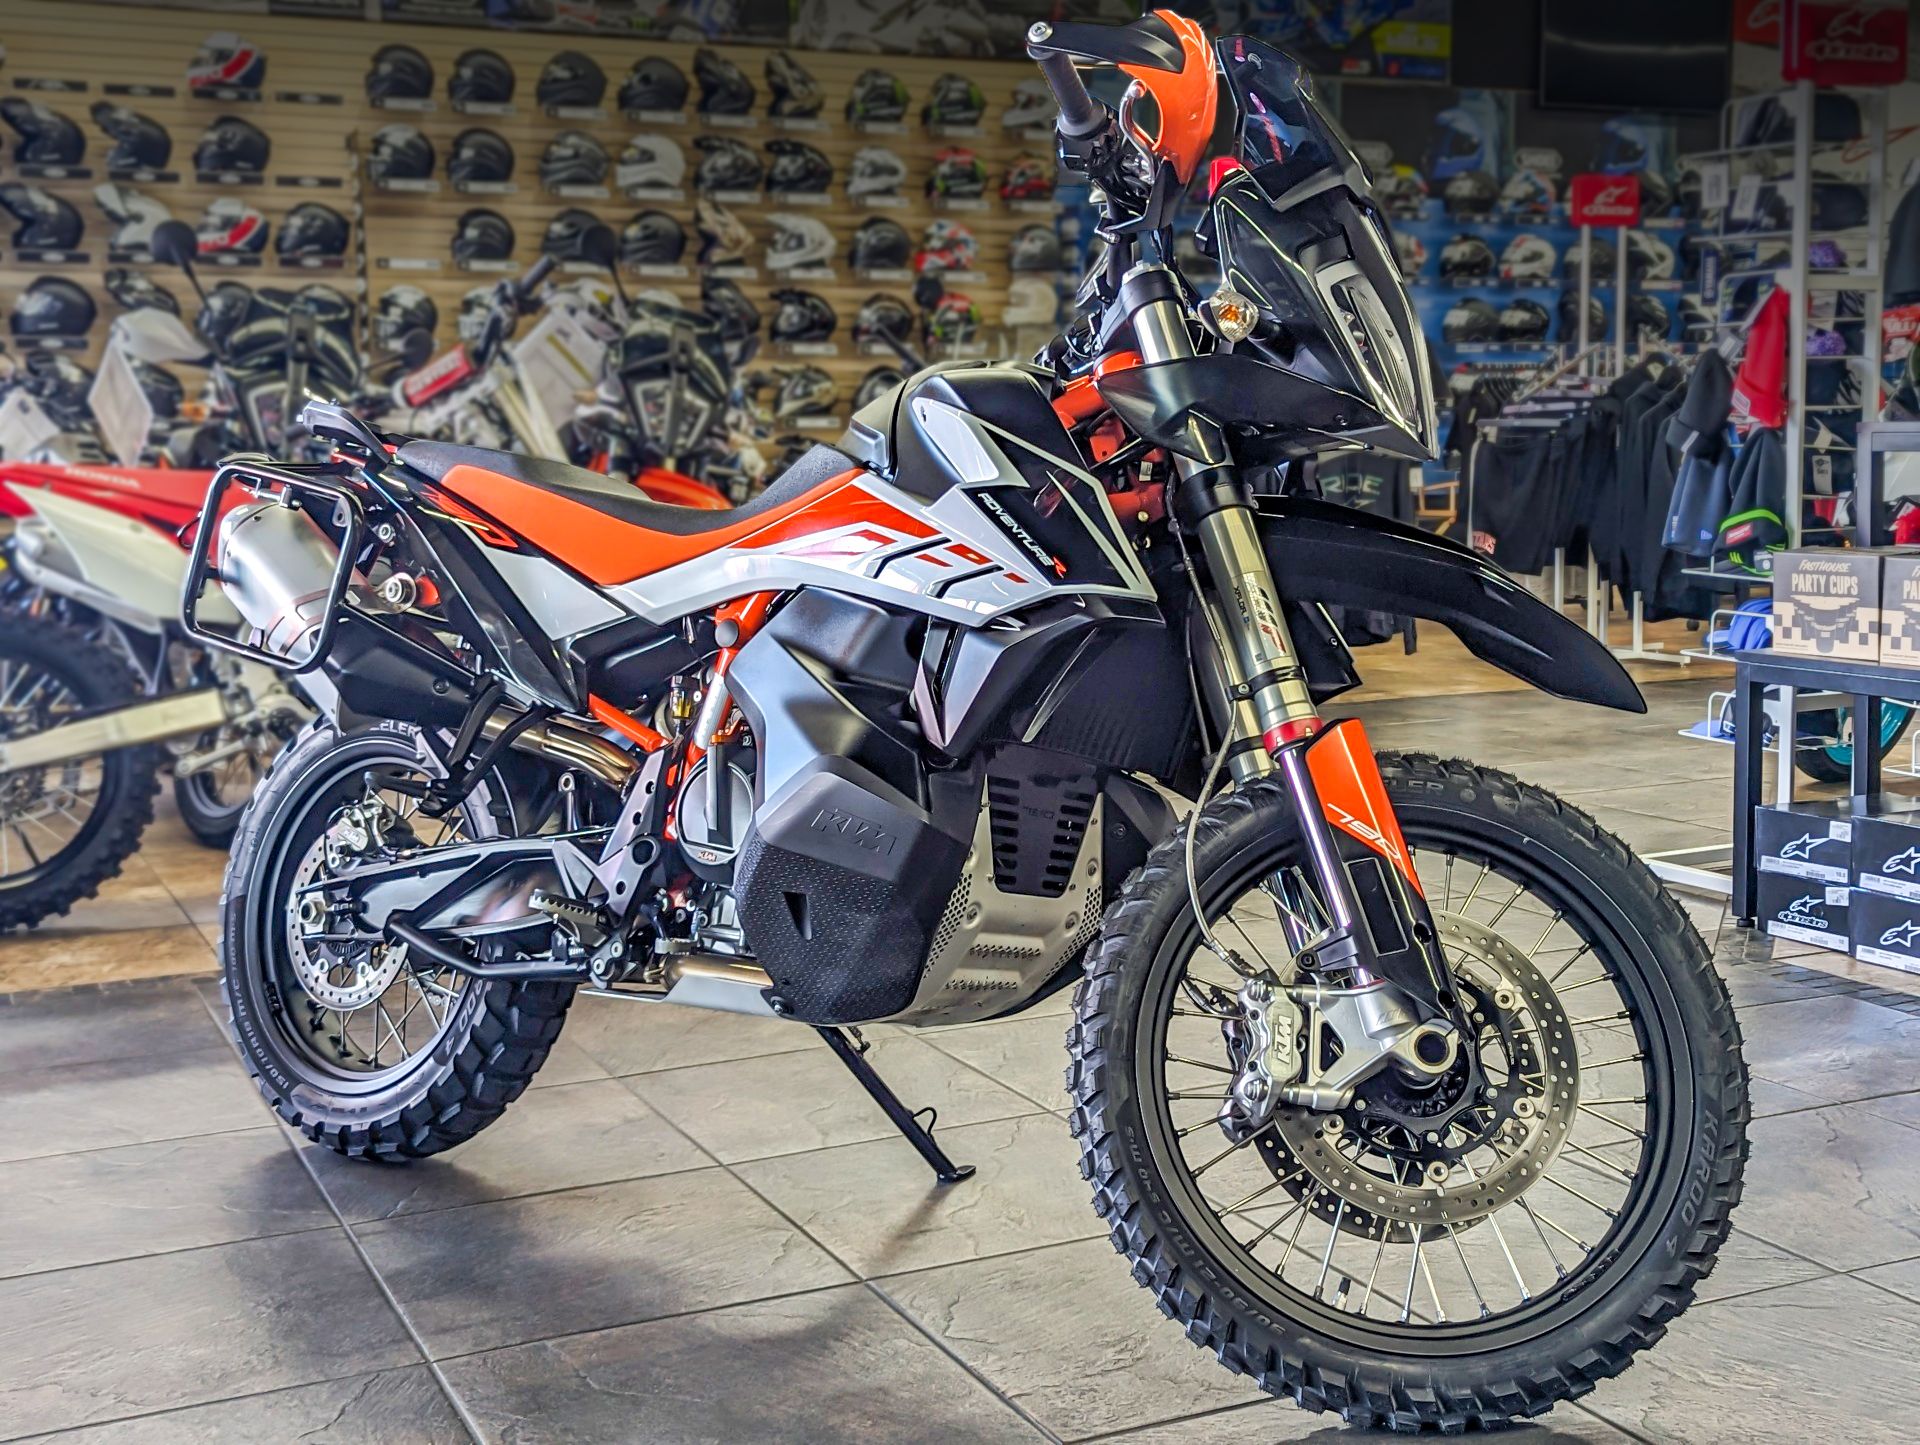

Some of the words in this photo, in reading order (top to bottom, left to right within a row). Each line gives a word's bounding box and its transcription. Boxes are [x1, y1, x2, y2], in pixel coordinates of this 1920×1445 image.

[1799, 560, 1851, 572] FASTHOUSE
[1792, 573, 1827, 594] PARTY
[1829, 575, 1858, 595] CUPS
[370, 719, 421, 740] ELER
[811, 808, 897, 856] KTM
[1273, 1015, 1293, 1064] KTM
[1681, 1110, 1718, 1227] KAROO
[1666, 1235, 1678, 1258] 4
